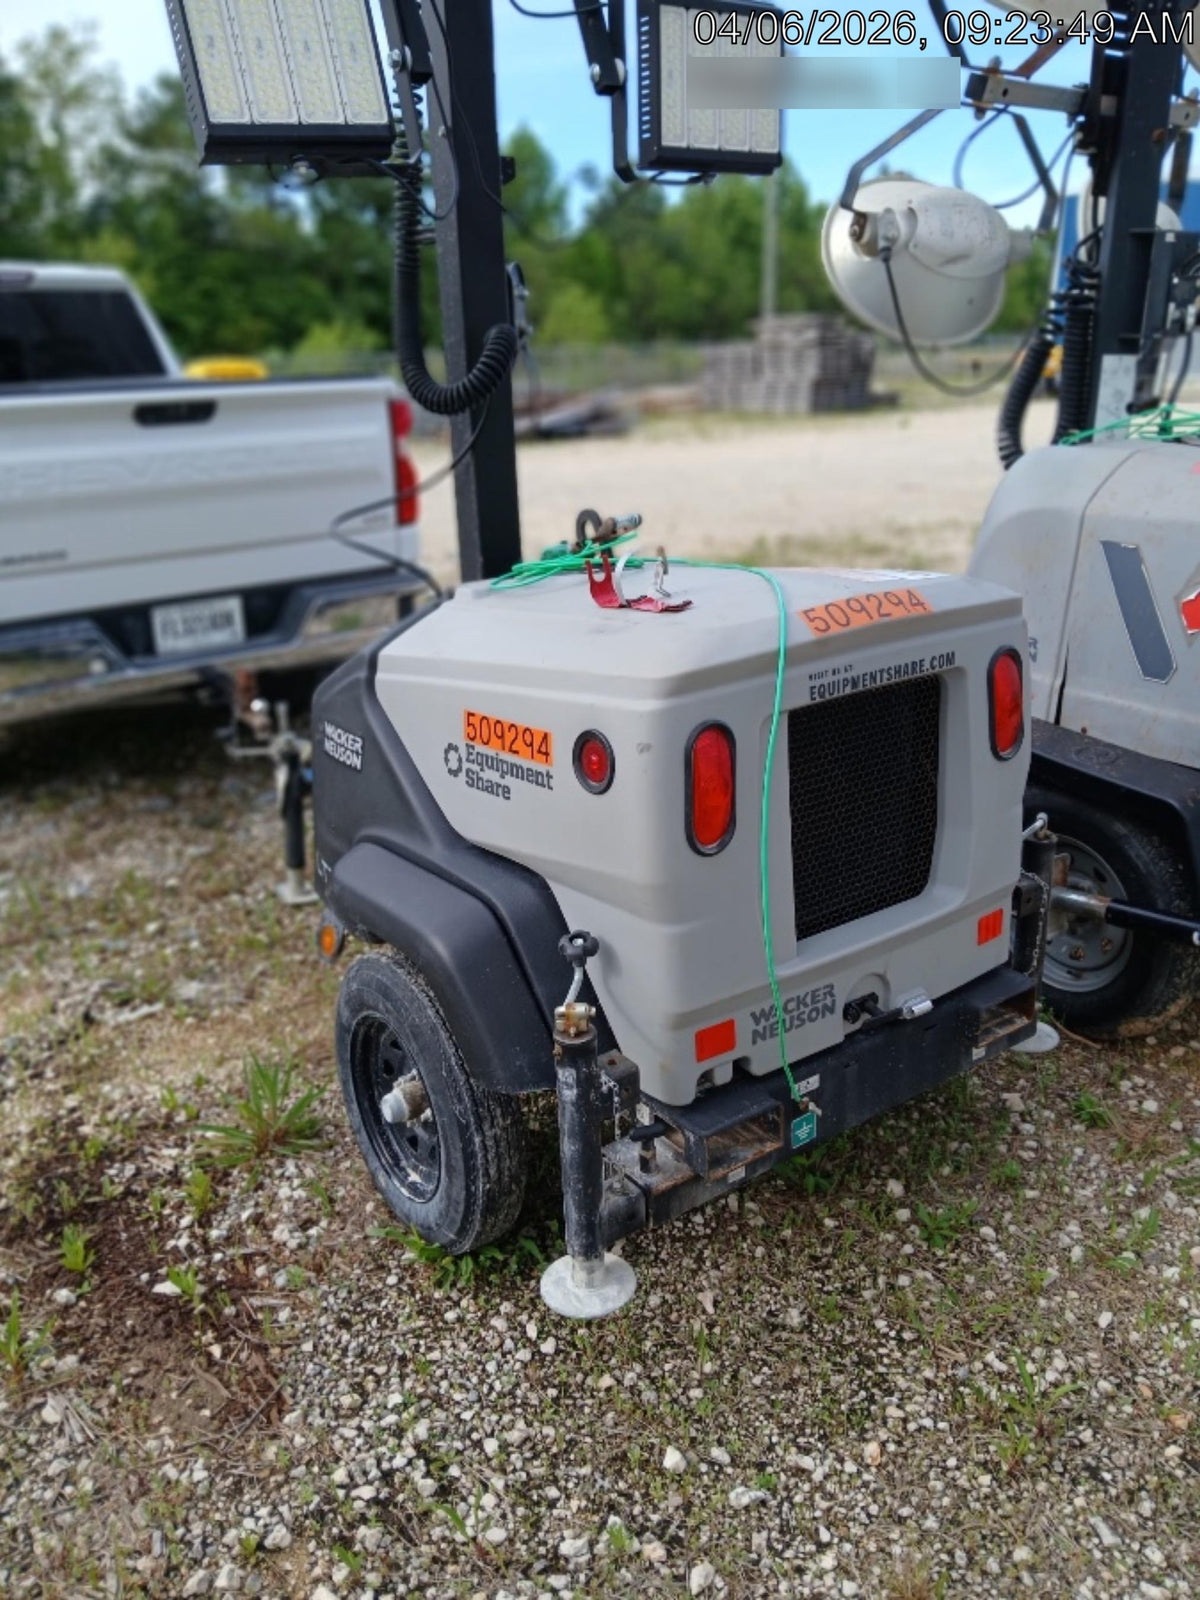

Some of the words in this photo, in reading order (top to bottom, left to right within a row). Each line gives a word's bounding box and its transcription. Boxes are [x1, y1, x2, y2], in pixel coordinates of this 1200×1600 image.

[803, 589, 928, 633] 509294
[809, 651, 956, 701] EQUIPMENTSHARE.COM
[324, 720, 363, 754] WACKER
[324, 737, 362, 770] NEUSON
[466, 711, 550, 763] 509294
[465, 742, 554, 791] Equipment
[465, 767, 511, 801] Share
